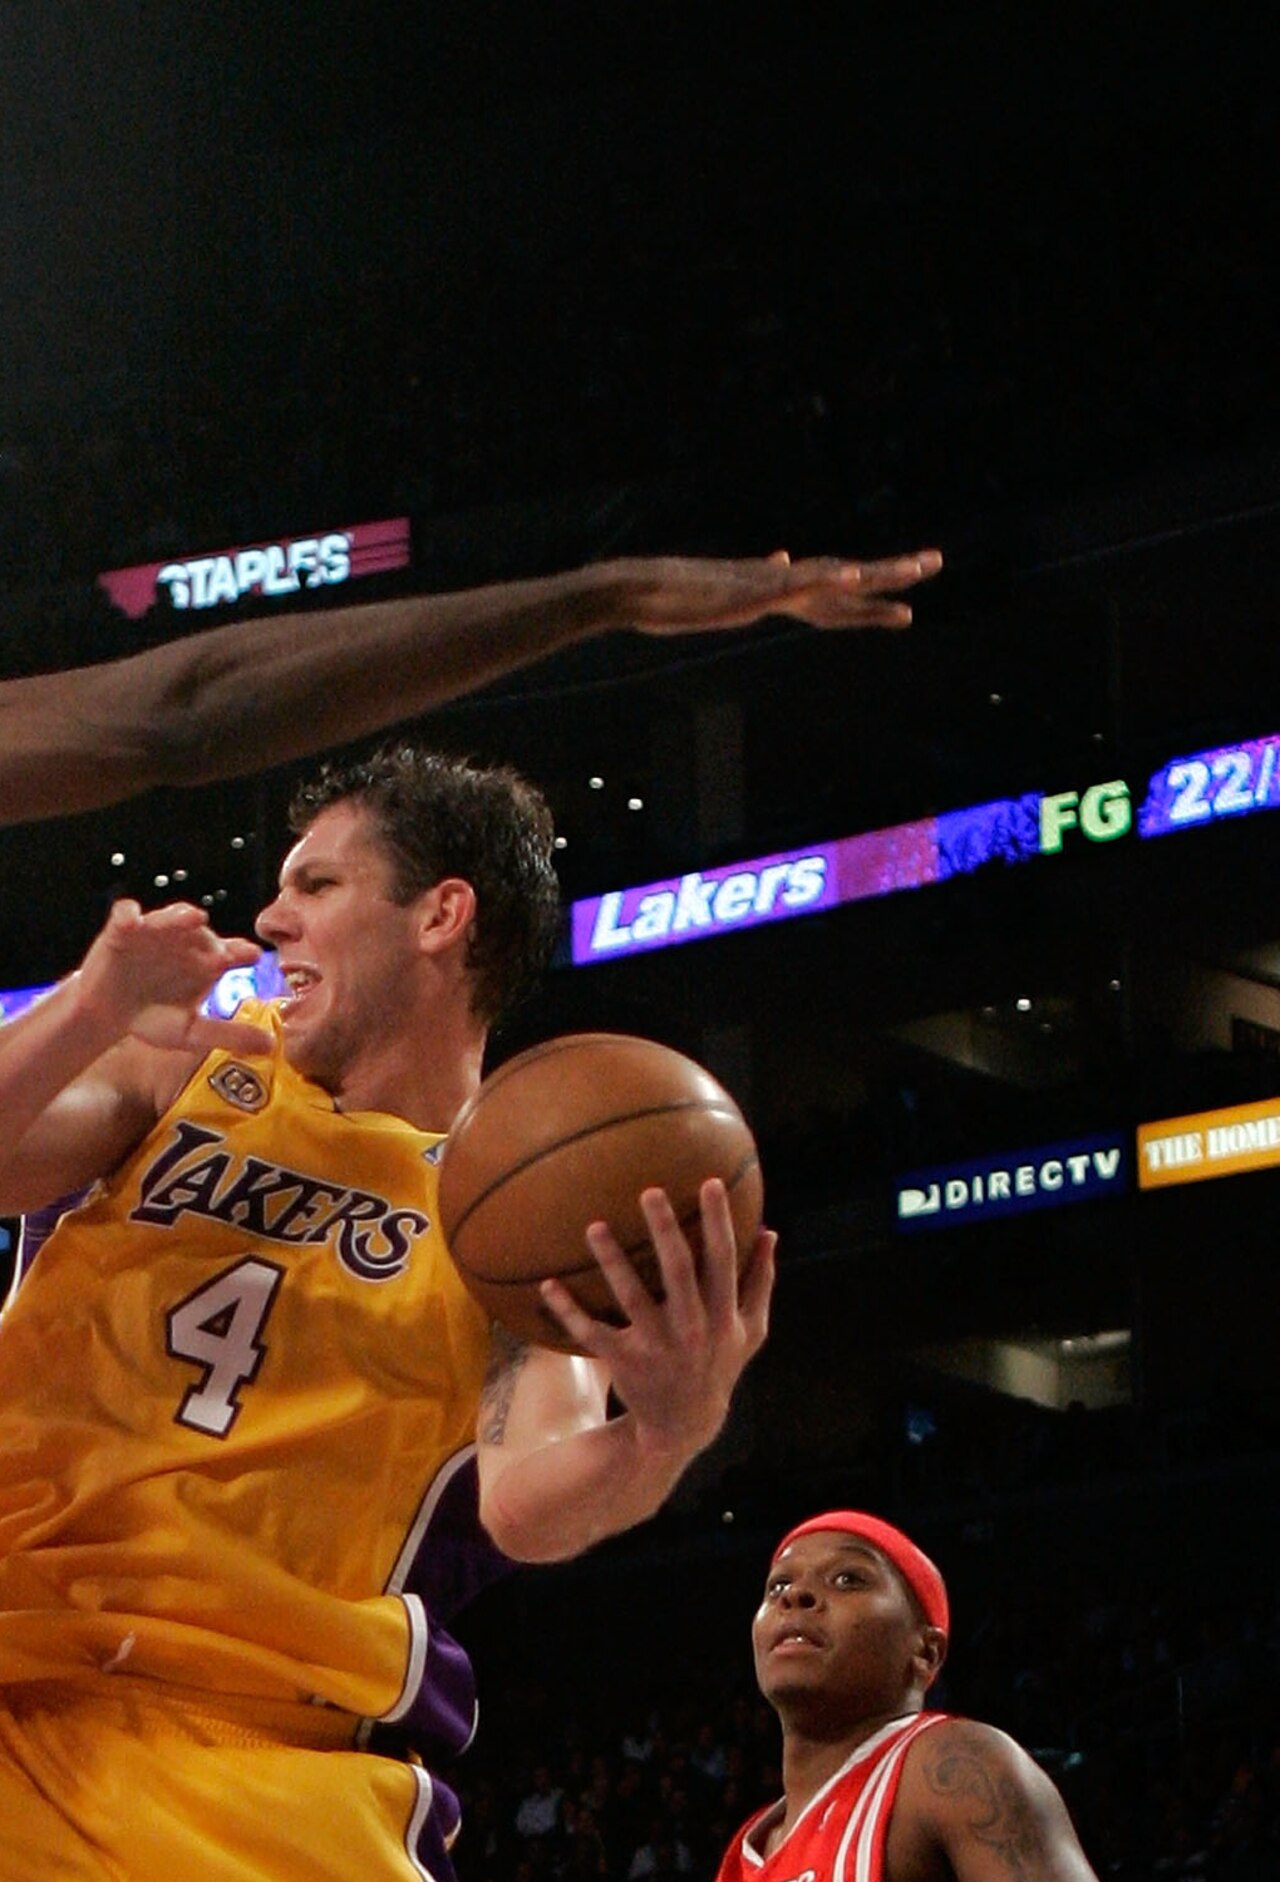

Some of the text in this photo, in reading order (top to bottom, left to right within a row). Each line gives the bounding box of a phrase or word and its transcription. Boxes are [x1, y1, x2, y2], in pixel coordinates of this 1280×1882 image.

[156, 533, 350, 609] STAPLES
[590, 855, 826, 952] Lakers
[1039, 780, 1131, 855] FG
[128, 1119, 429, 1284] LAKERS
[946, 1149, 1121, 1209] DIRECTV
[1145, 1131, 1203, 1173] THE
[166, 1253, 288, 1440] 4
